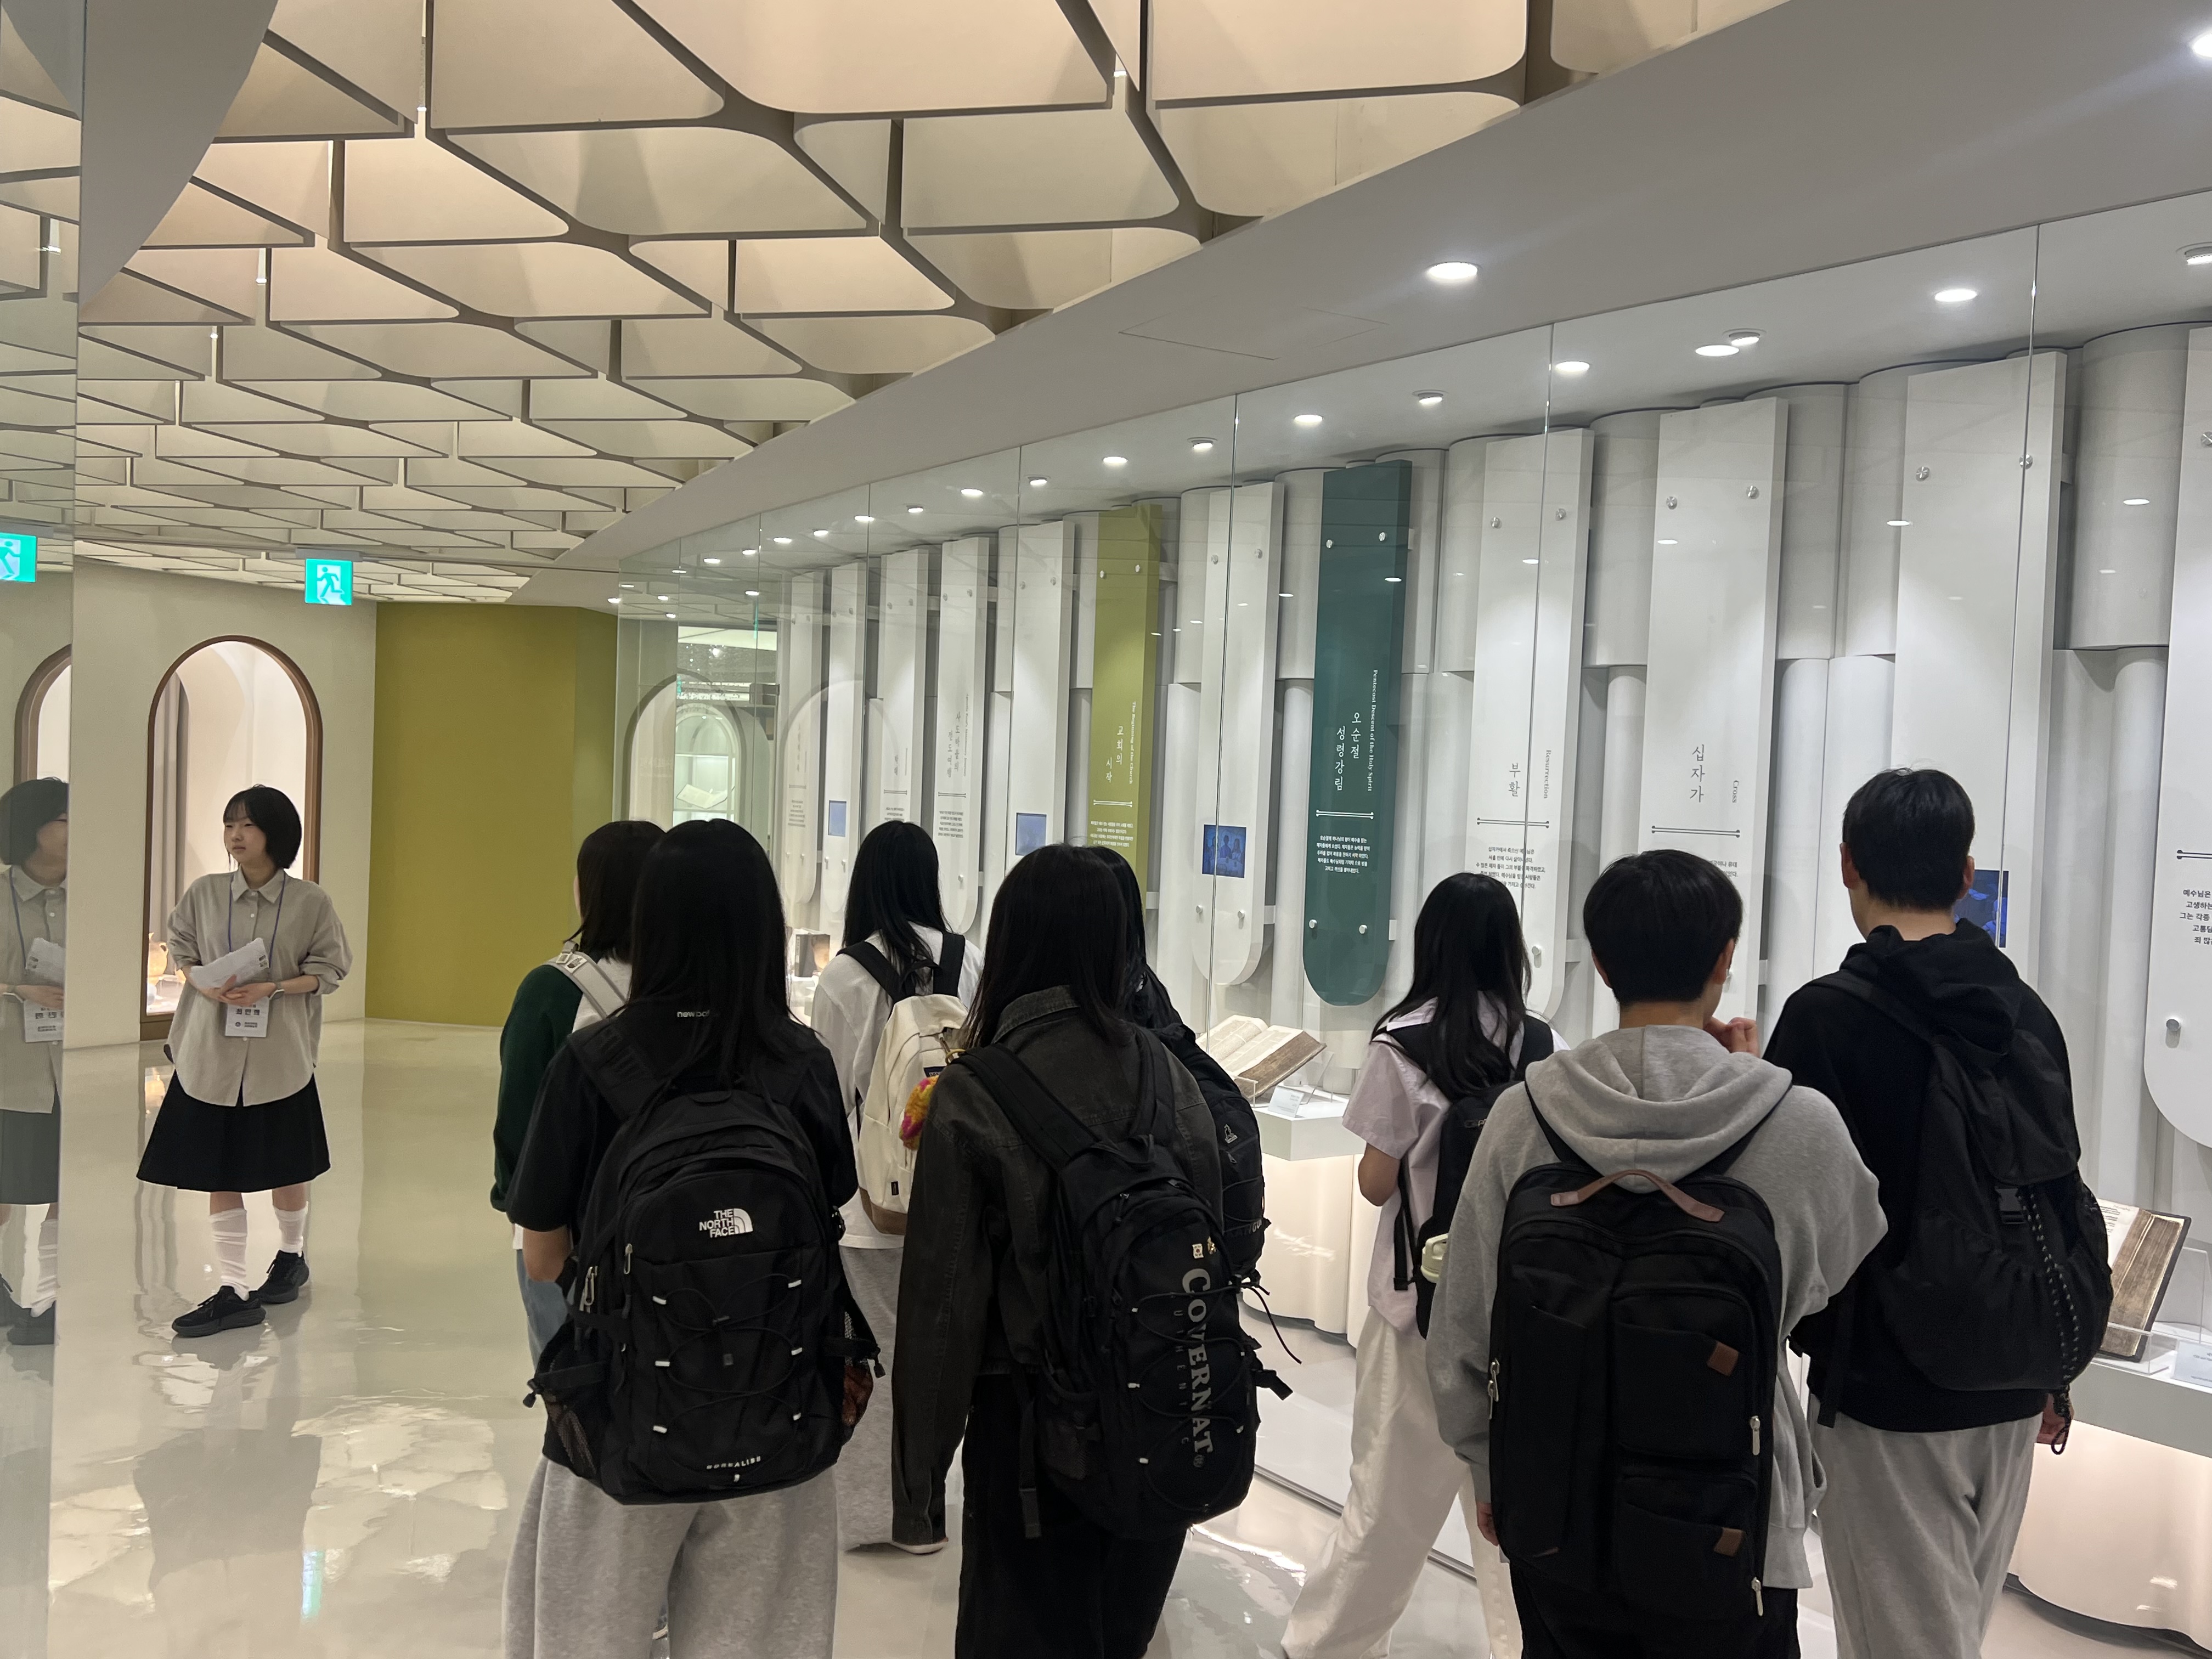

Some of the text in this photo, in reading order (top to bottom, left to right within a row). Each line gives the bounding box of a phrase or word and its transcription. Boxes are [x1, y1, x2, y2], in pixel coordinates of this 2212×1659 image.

[1350, 712, 1362, 759] 오순절
[1106, 757, 1113, 783] 시작
[1335, 725, 1346, 791] 성령강림
[1508, 763, 1521, 797] 부활
[1543, 750, 1551, 799] Resurrection
[1690, 744, 1706, 803] 십자가
[2183, 889, 2211, 898] 예수님은
[2186, 901, 2212, 910] 고생하는
[699, 1217, 734, 1231] NORTH
[713, 1209, 733, 1219] THE
[709, 1226, 735, 1238] FACE
